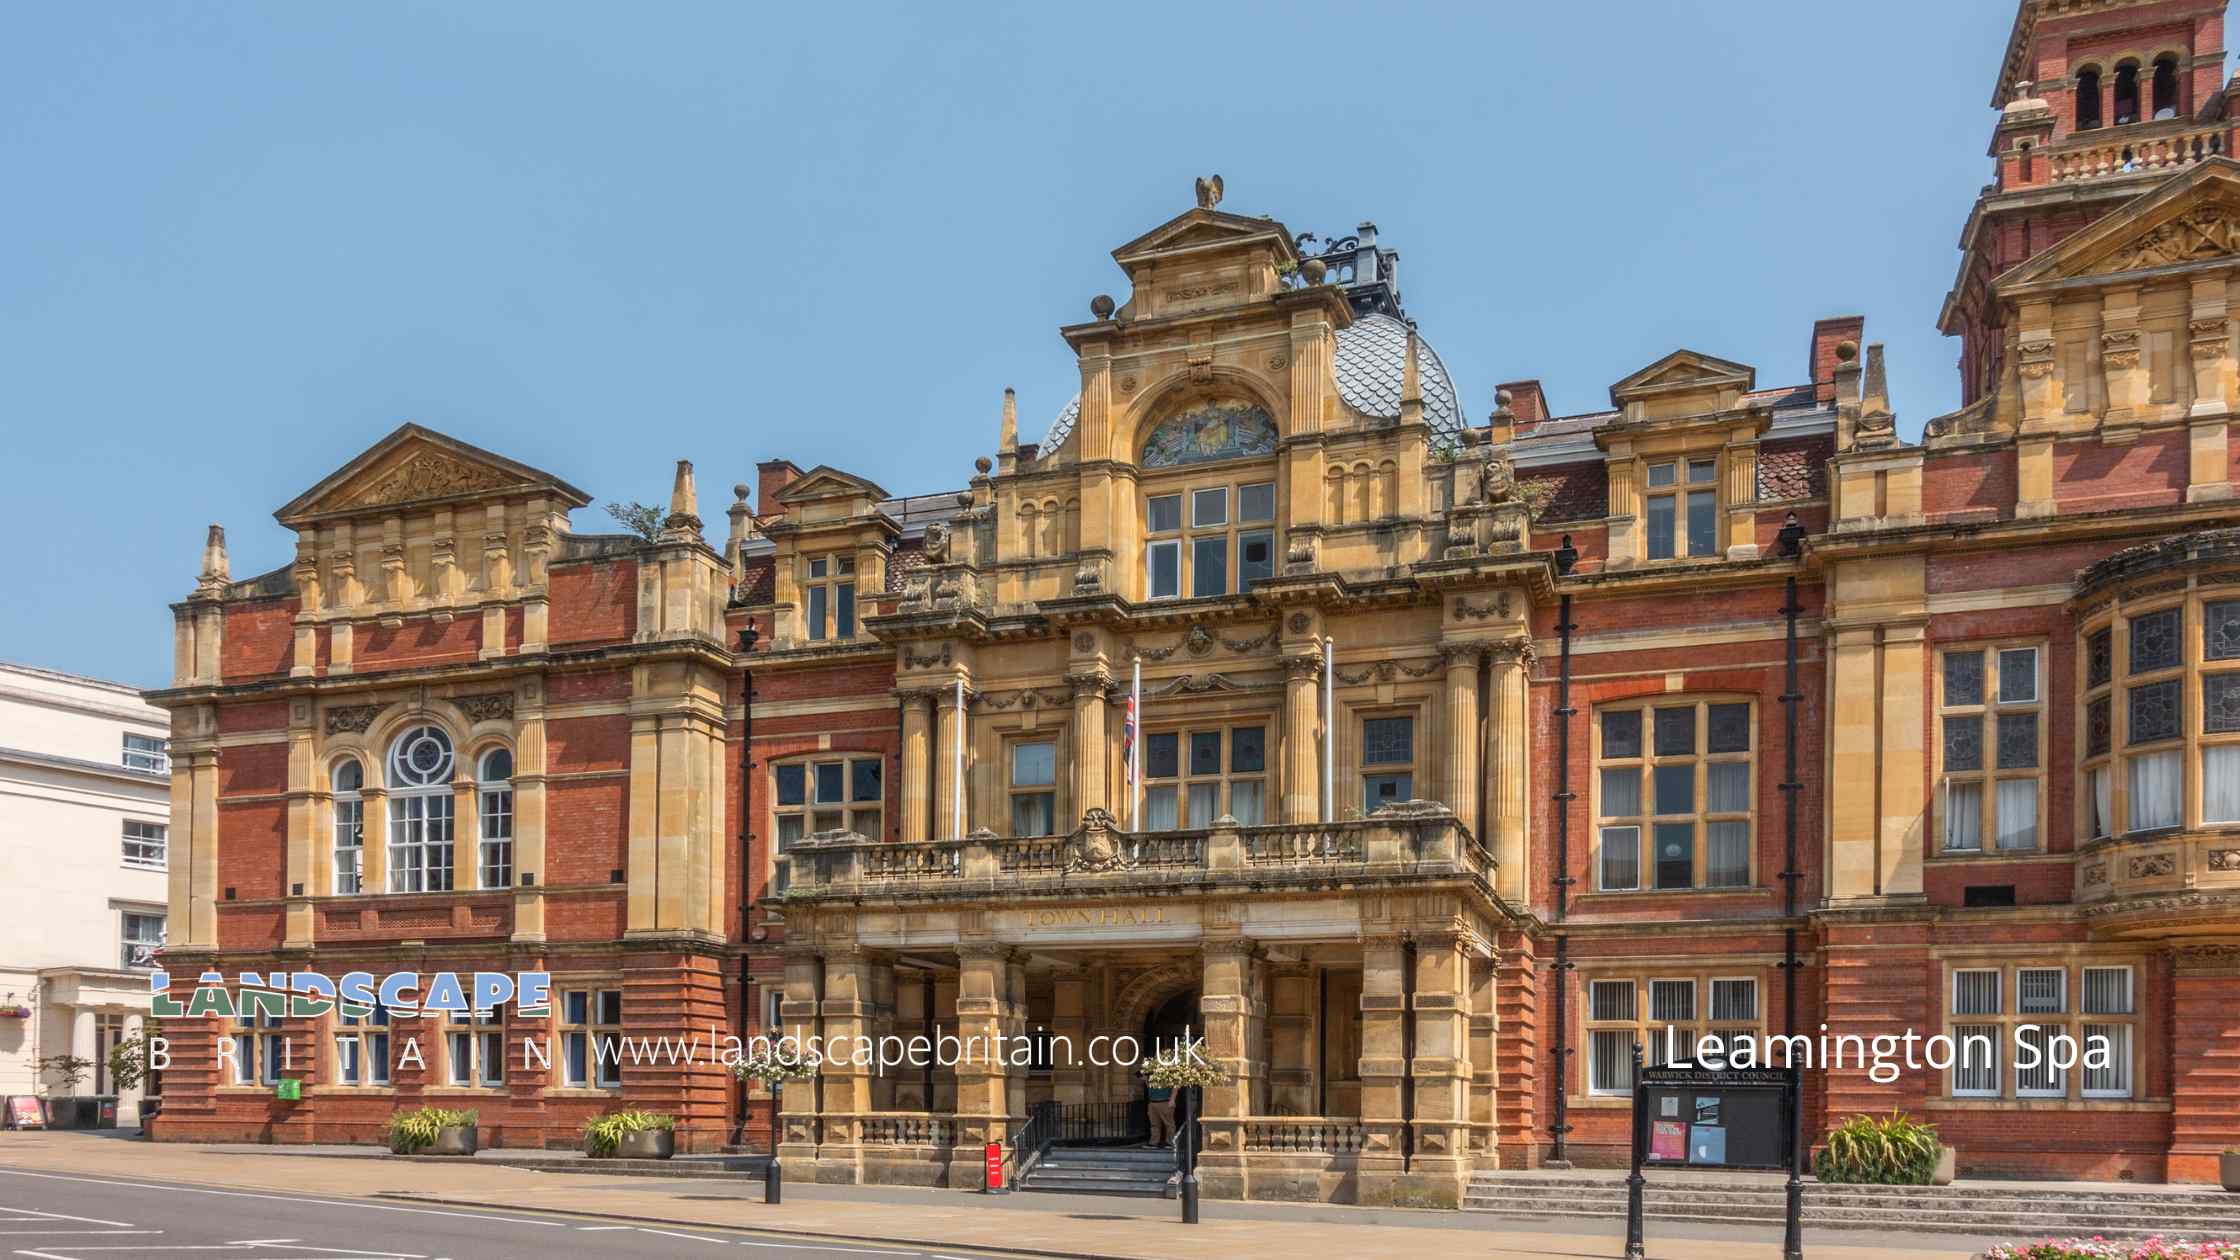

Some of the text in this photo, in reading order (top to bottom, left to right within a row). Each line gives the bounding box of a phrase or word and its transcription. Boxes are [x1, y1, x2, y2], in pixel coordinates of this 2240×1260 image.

[1025, 908, 1170, 928] TOWN HALL
[1648, 1071, 1786, 1081] WARWICK DISTRICT COUNCIL
